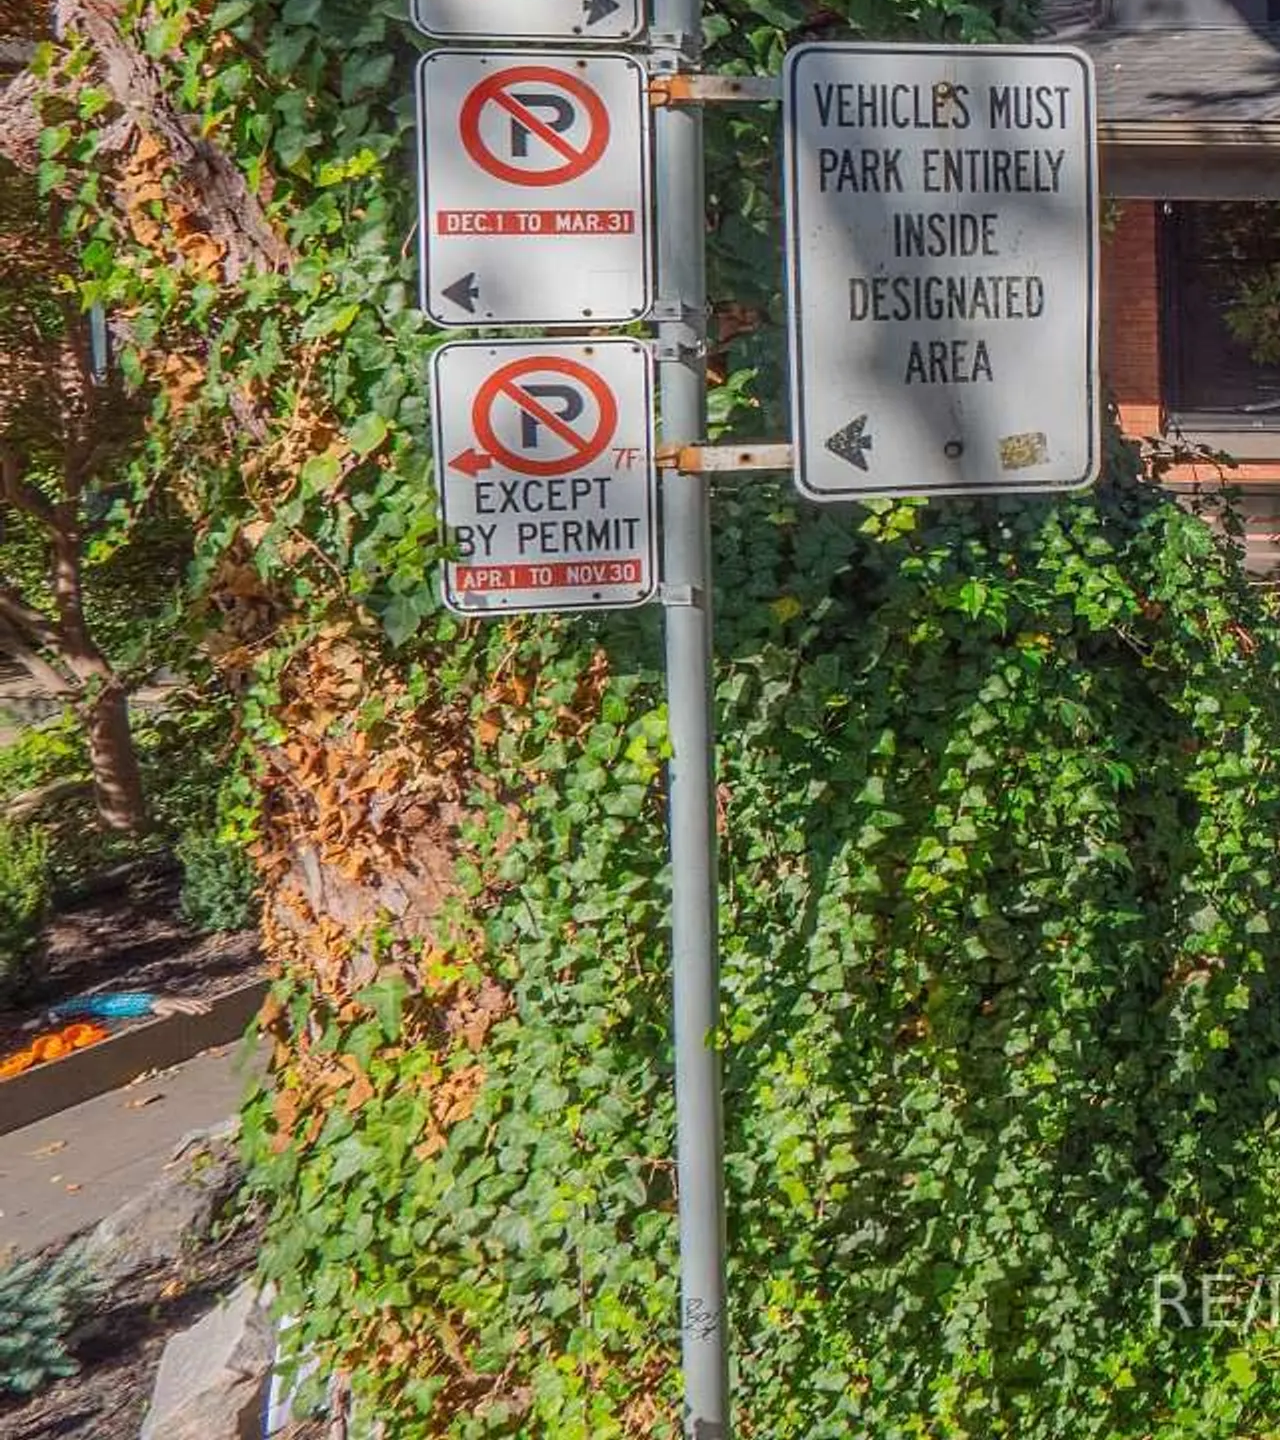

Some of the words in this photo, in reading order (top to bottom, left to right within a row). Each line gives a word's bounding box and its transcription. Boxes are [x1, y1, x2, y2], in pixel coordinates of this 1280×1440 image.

[813, 82, 971, 130] VEHICLES
[989, 86, 1071, 130] MUST
[818, 148, 904, 194] PARK
[923, 149, 1066, 194] ENTIRELY
[519, 213, 542, 232] TO
[893, 213, 999, 258] INSIDE
[848, 276, 1044, 322] DESIGNATED
[904, 340, 994, 385] AREA
[475, 477, 612, 513] EXCEPT
[454, 523, 498, 558] BY
[517, 517, 641, 555] PERMIT
[527, 567, 551, 585] TO
